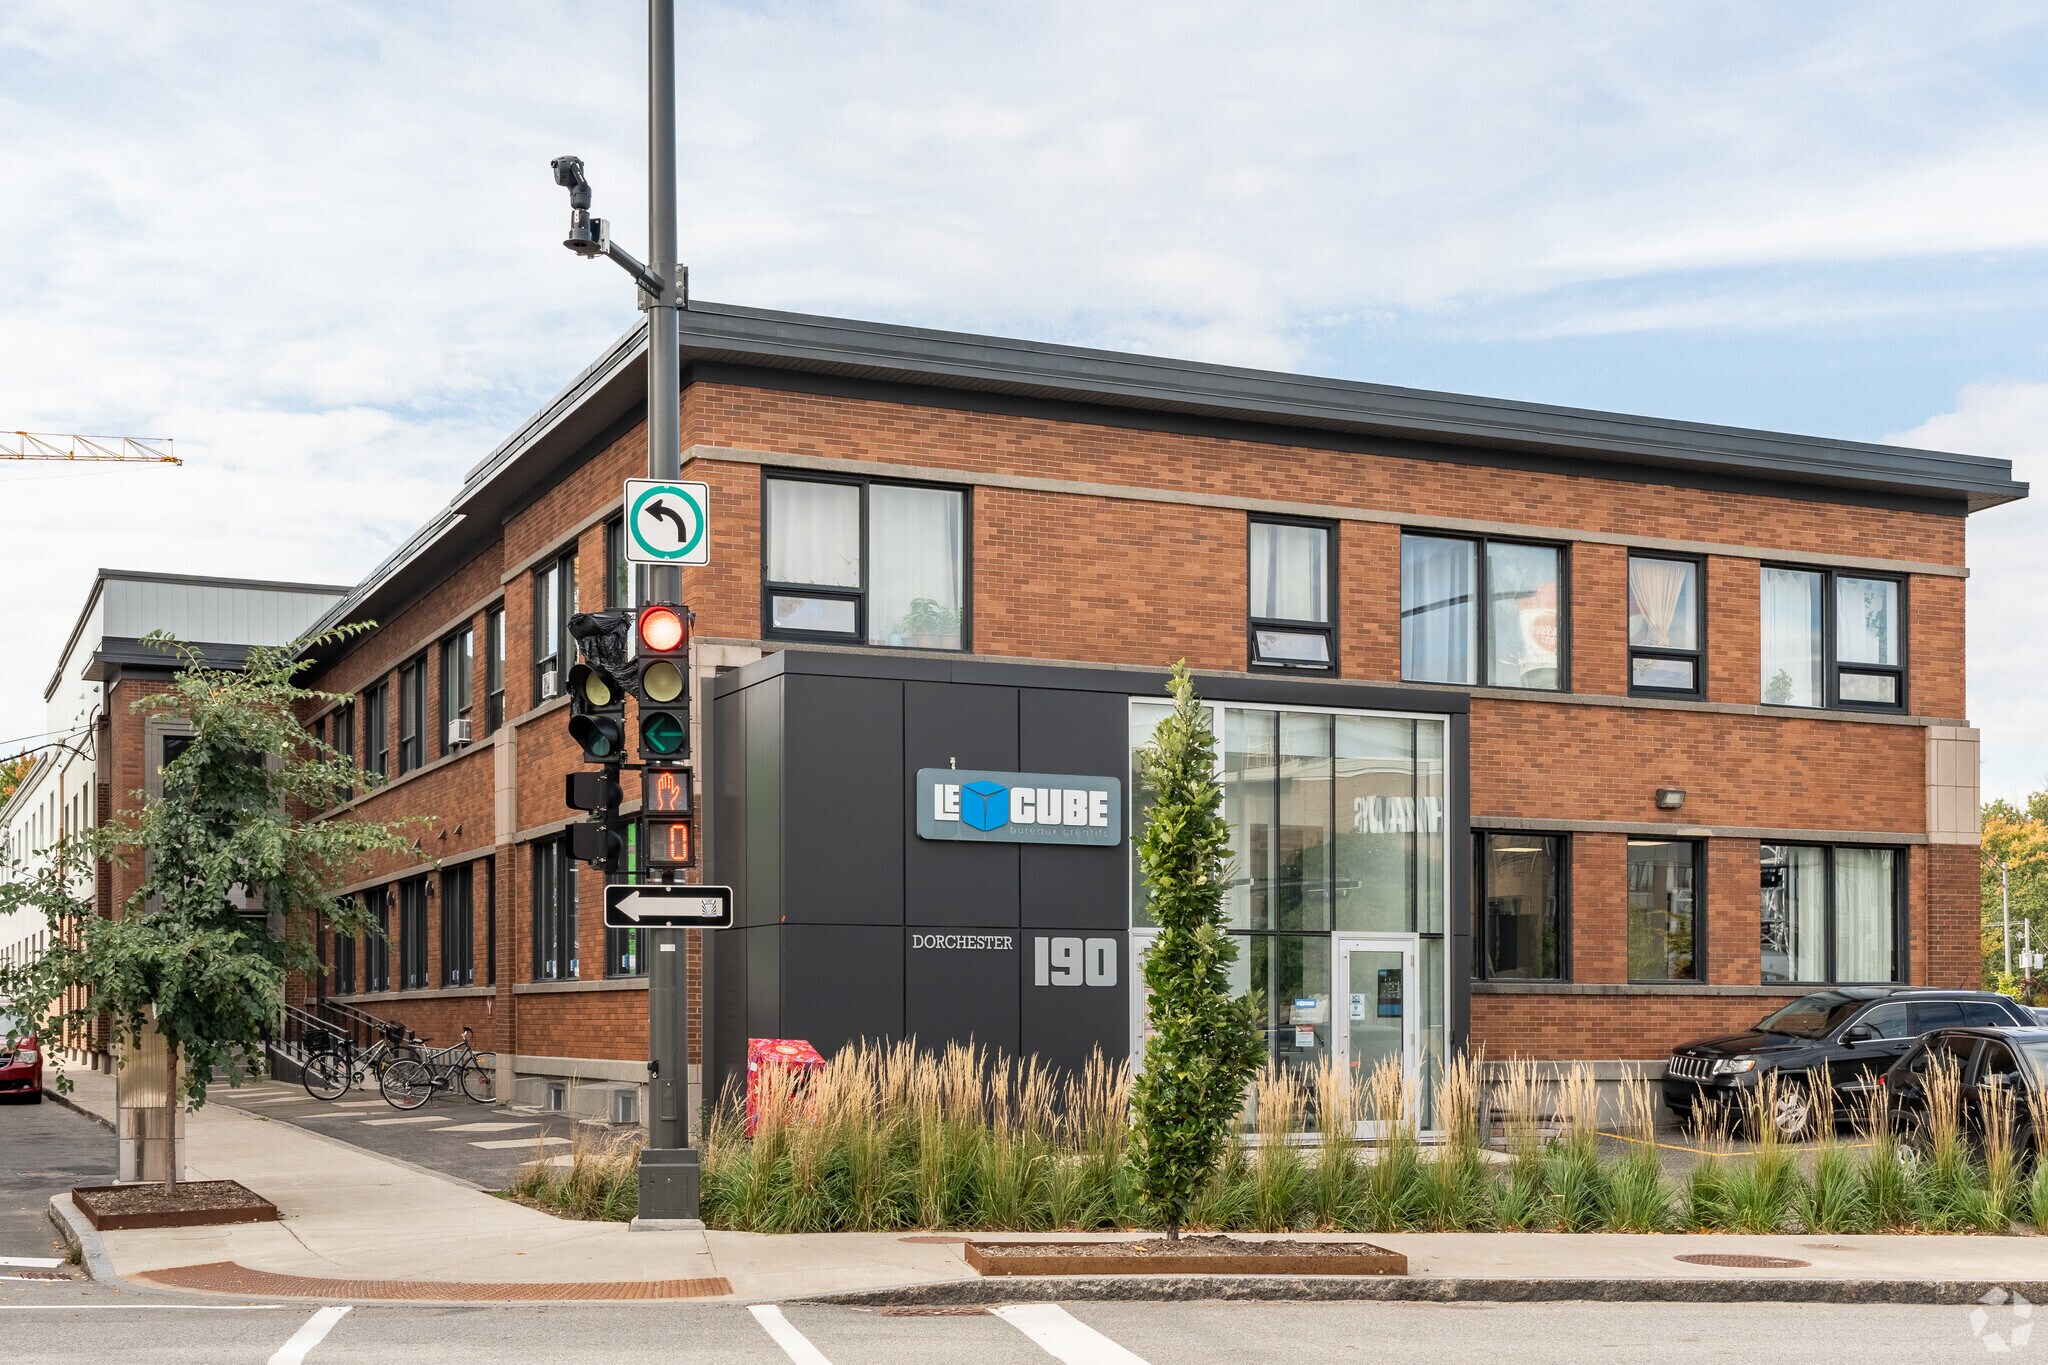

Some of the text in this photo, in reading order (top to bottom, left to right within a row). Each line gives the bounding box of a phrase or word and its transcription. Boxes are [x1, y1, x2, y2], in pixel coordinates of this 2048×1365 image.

[934, 783, 1108, 827] LE CUBE
[670, 824, 687, 861] 0
[1009, 826, 1108, 838] bureaux créatifs
[912, 934, 1013, 950] DORCHESTER
[1034, 936, 1118, 987] 190
